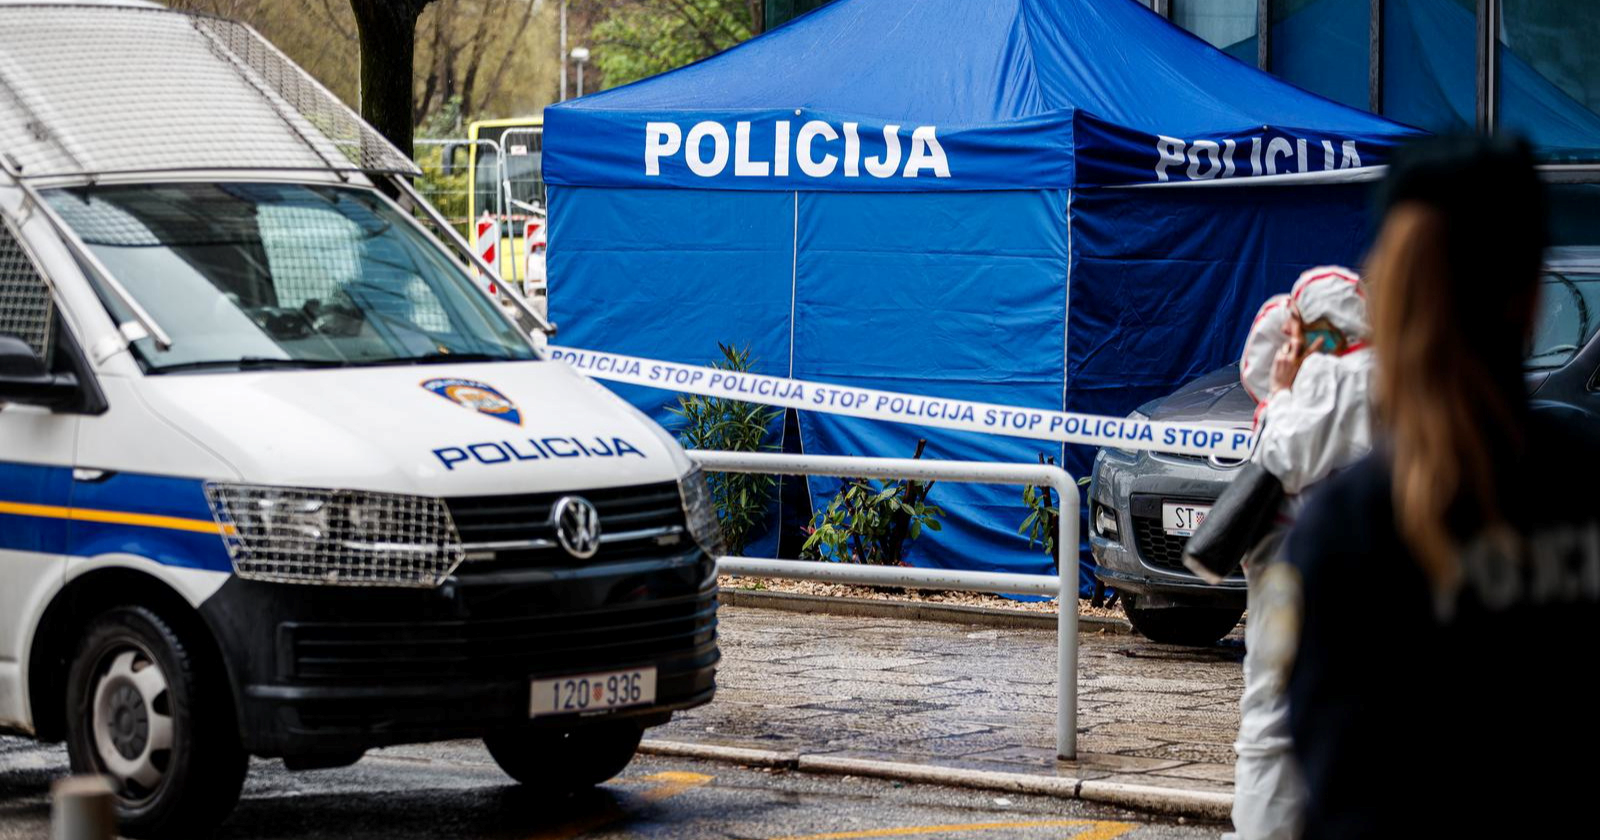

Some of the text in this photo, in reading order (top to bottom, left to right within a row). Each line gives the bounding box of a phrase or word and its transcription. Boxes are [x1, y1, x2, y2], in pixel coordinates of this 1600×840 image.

[645, 120, 951, 178] POLICIJA
[649, 365, 703, 386] STOP
[709, 373, 804, 400] POLICIJA
[812, 388, 868, 409] STOP
[875, 395, 974, 422] POLICIJA
[984, 409, 1042, 430] STOP
[1050, 416, 1153, 442] POLICIJA
[1163, 427, 1223, 449] STOP
[432, 437, 647, 470] POLICIJA
[1176, 507, 1194, 528] ST
[553, 672, 642, 711] 120 936
